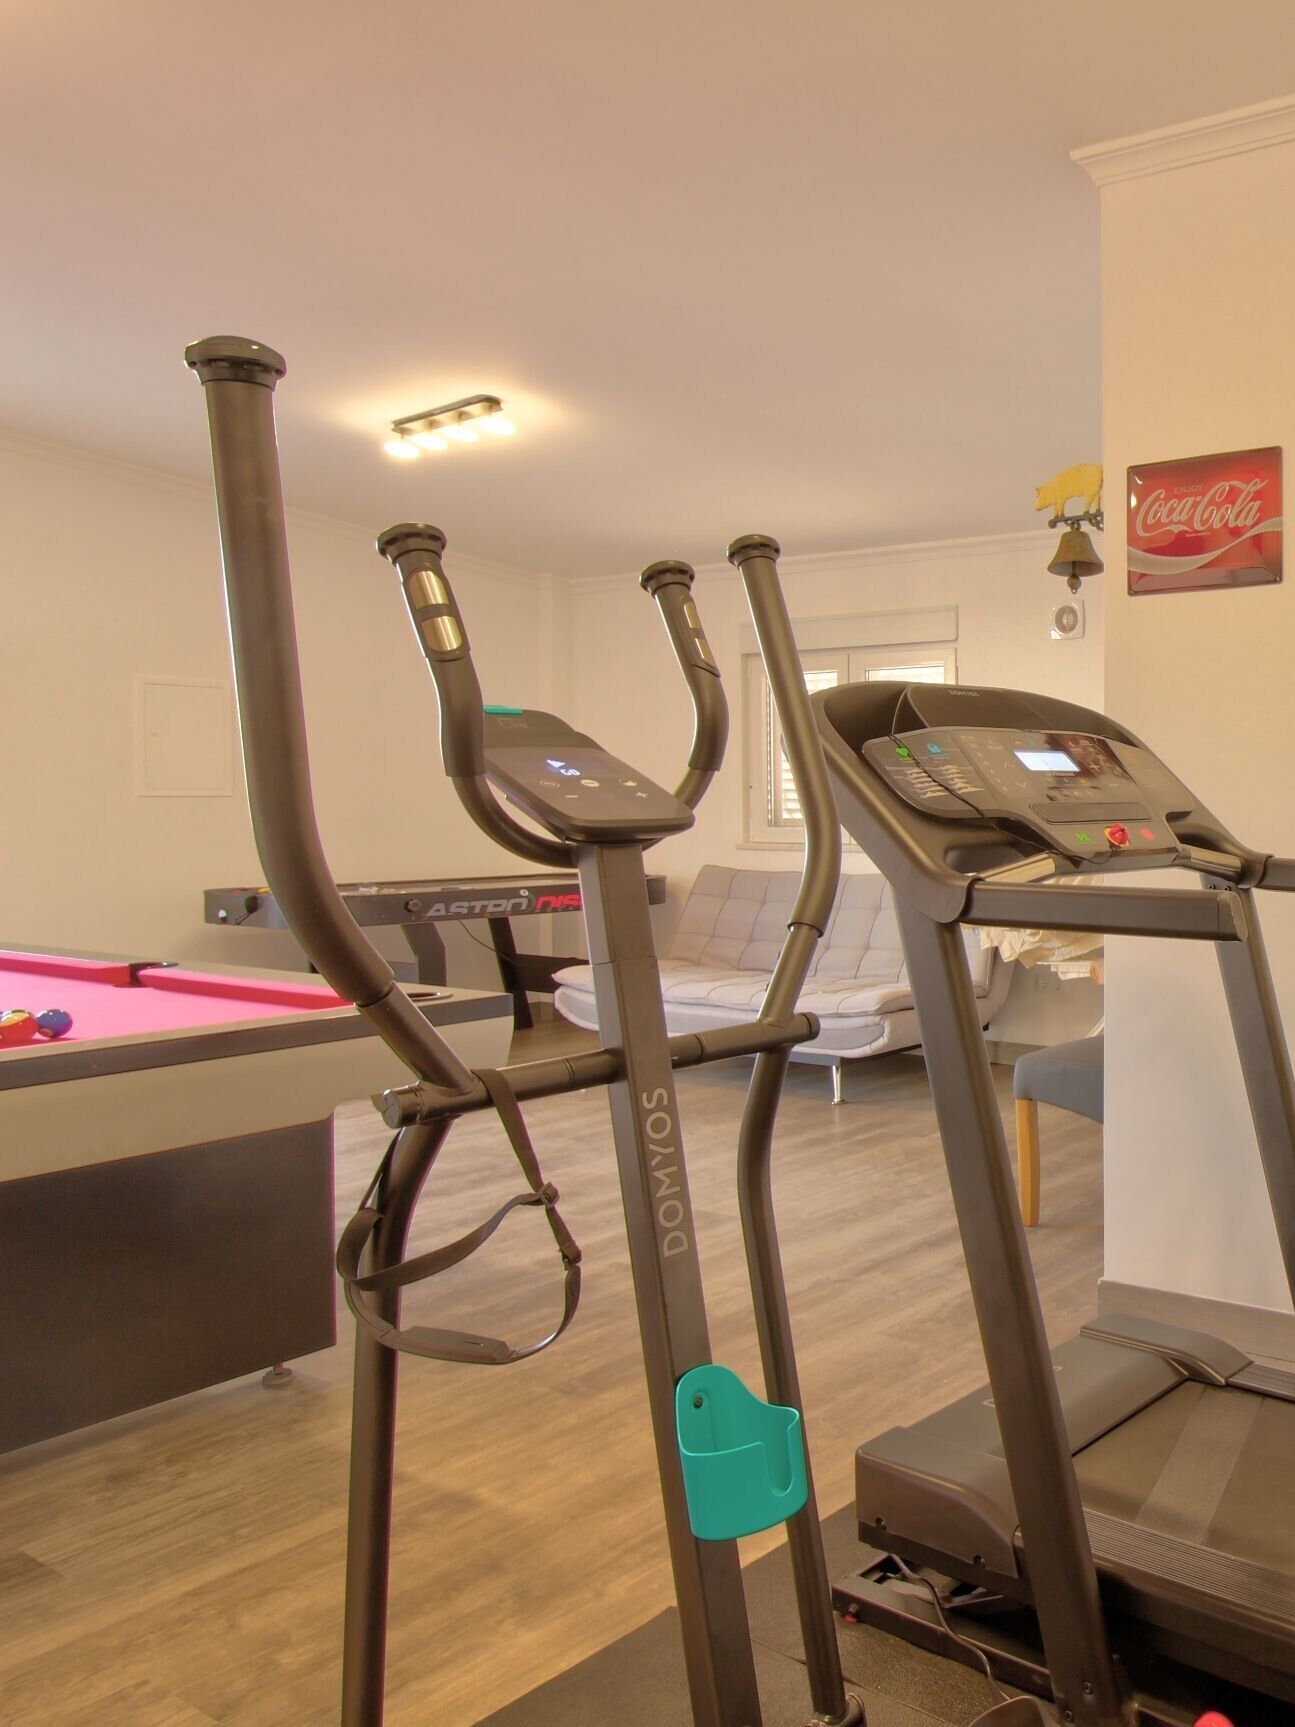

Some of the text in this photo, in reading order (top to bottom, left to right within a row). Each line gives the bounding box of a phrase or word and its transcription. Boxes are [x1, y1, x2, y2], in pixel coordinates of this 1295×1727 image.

[1136, 478, 1268, 537] Coca-Cola
[1174, 484, 1204, 494] ENJOY
[642, 1087, 689, 1258] DOMYOS
